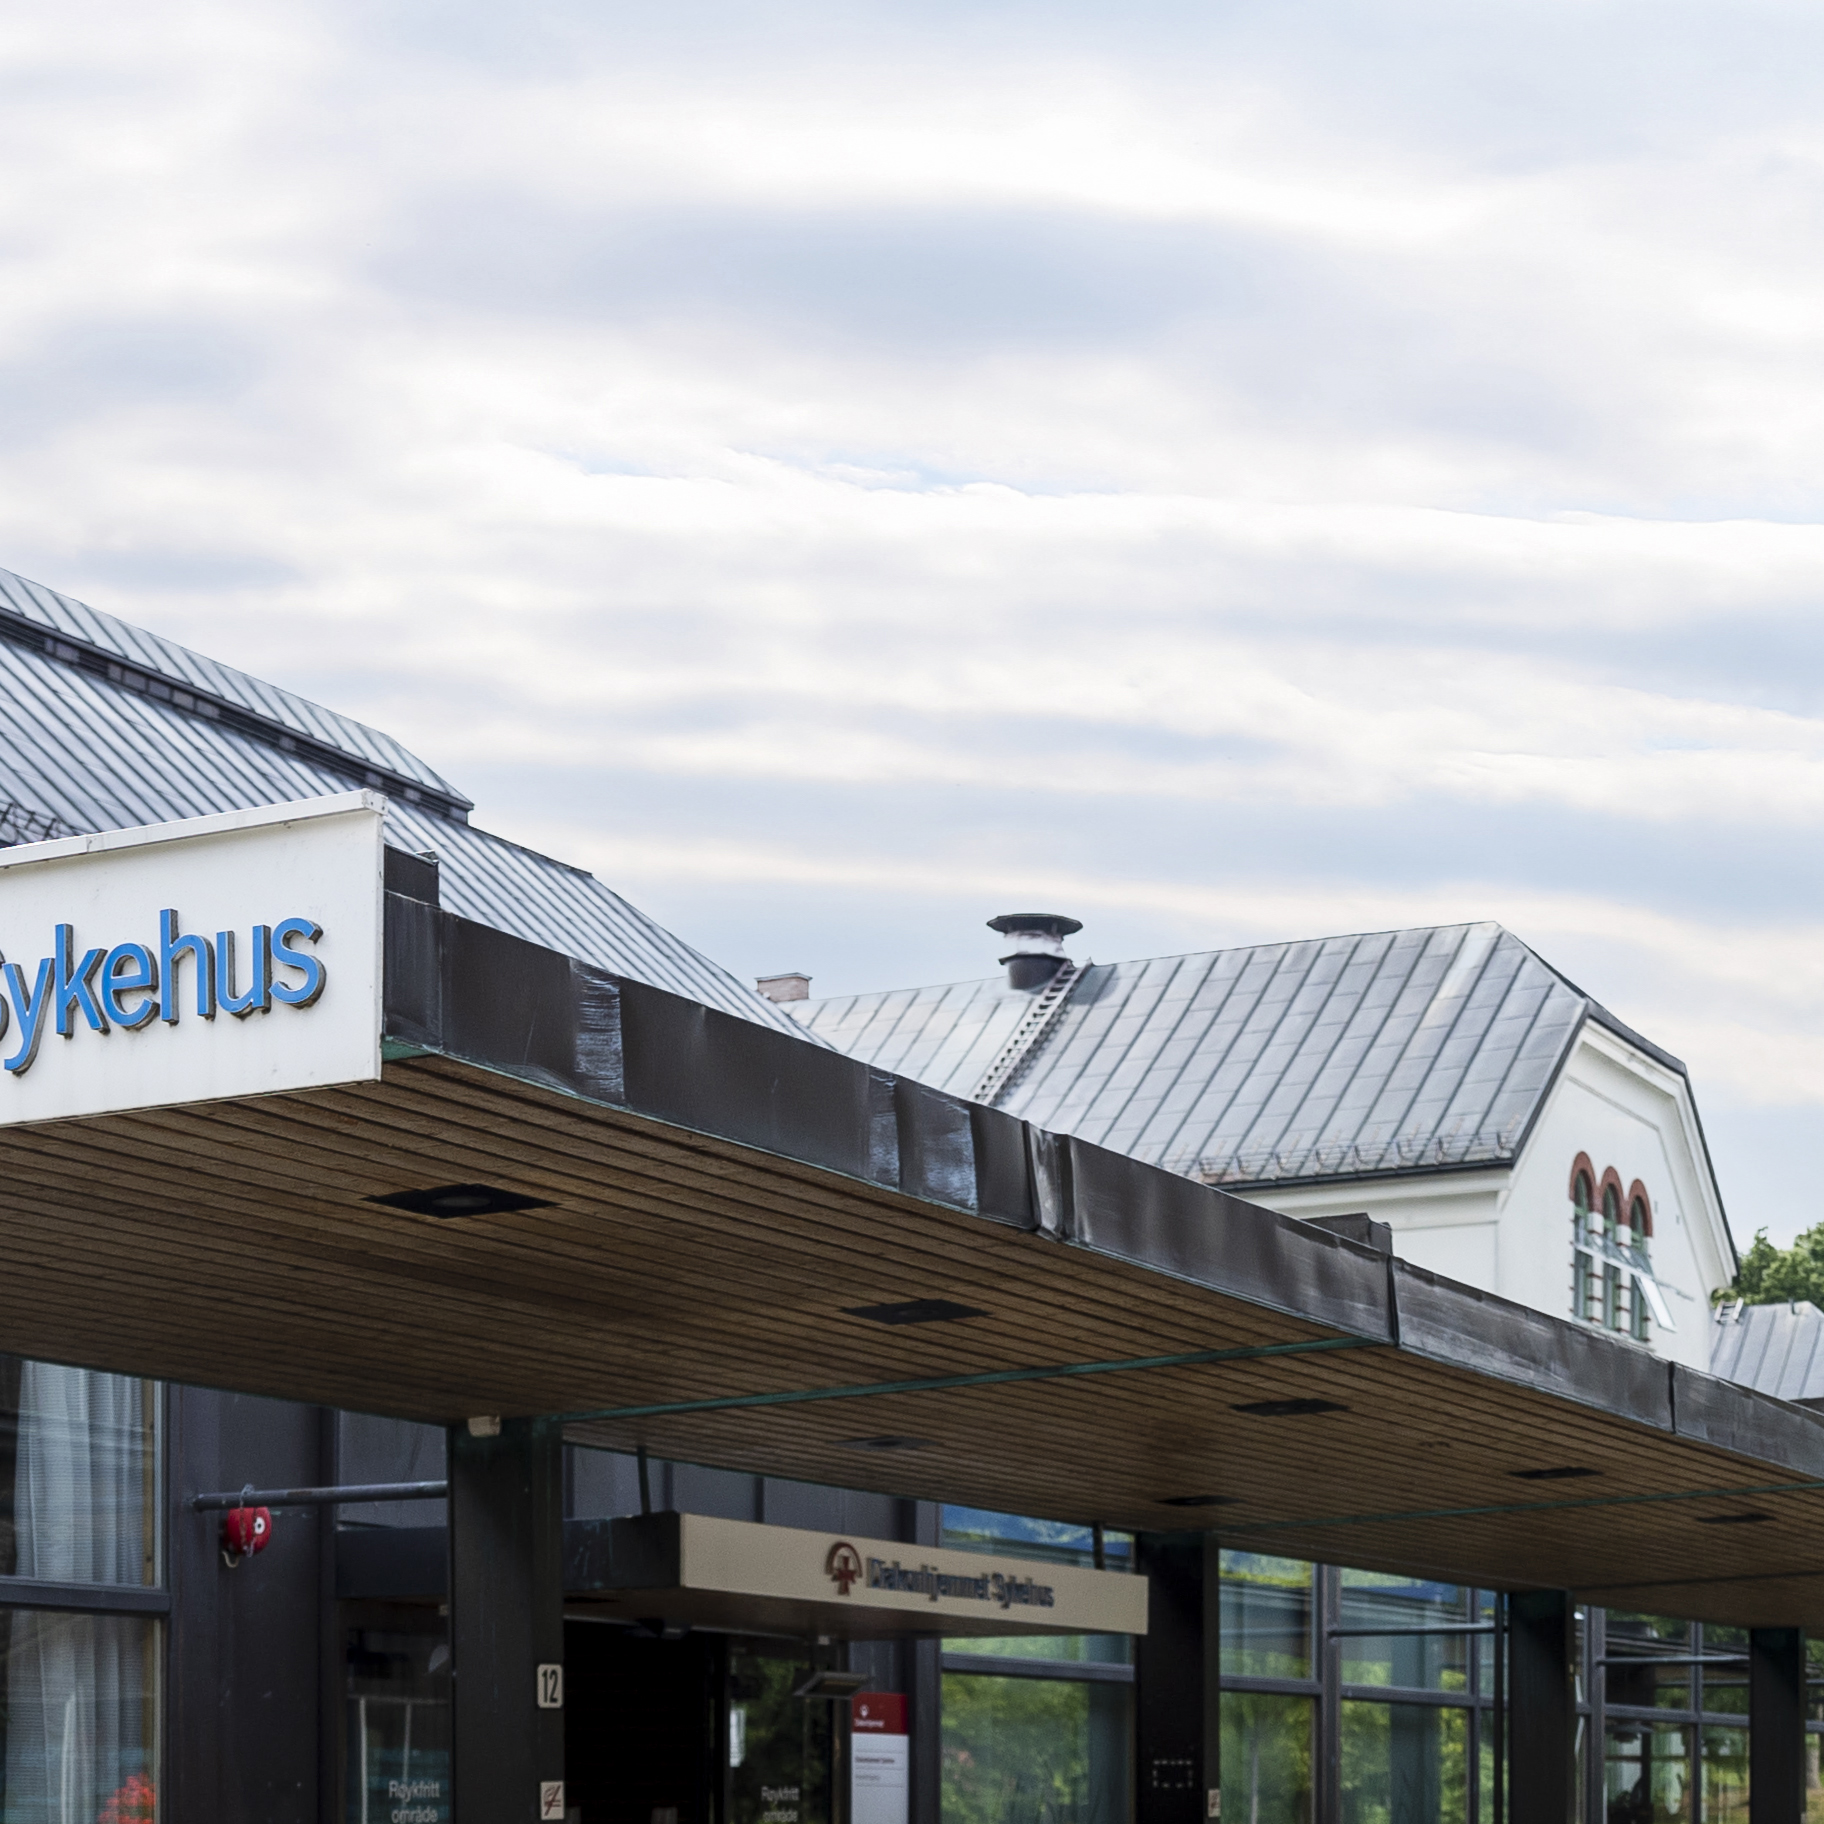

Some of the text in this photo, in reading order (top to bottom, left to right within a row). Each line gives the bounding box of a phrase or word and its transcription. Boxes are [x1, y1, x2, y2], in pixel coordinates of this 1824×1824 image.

[541, 1669, 558, 1703] 12
[388, 1780, 440, 1802] Røykfritt
[391, 1806, 438, 1823] område
